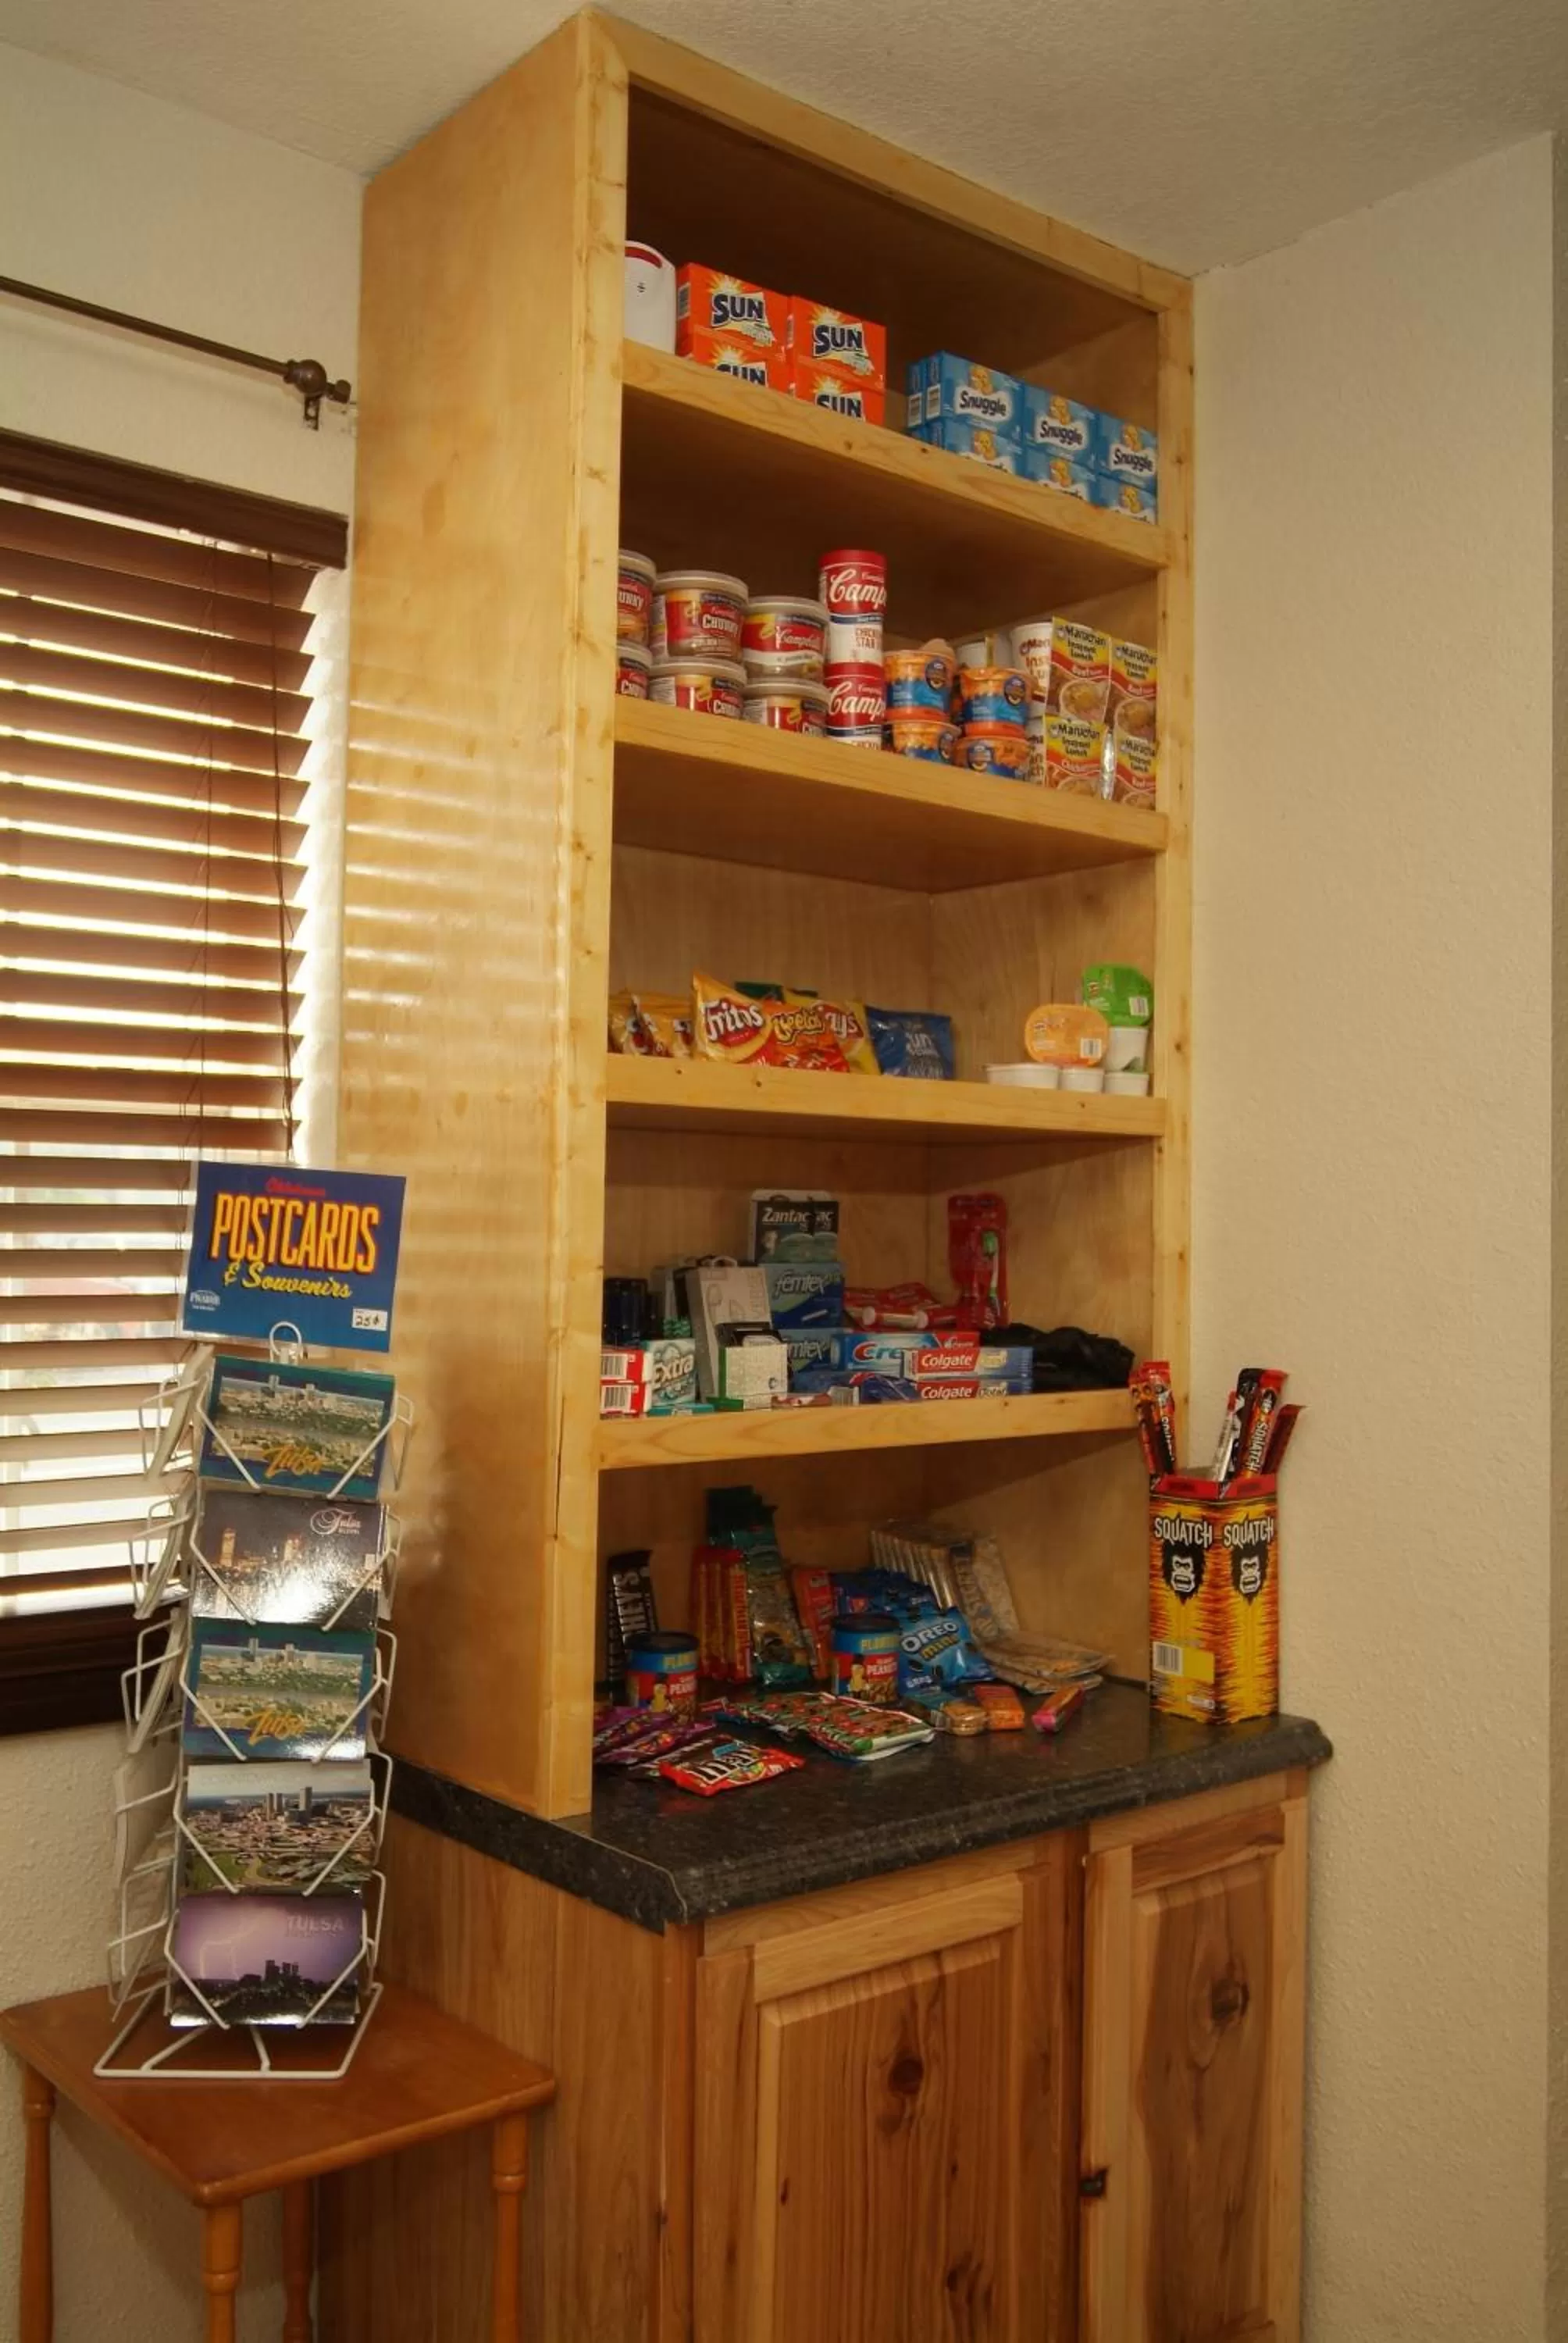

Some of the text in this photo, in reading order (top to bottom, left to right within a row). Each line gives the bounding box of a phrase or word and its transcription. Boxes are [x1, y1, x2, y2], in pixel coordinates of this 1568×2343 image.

[711, 292, 764, 326] SUN
[814, 323, 863, 355] SUN
[959, 390, 1007, 415] Snuggle
[1039, 420, 1083, 446] Snuggle
[1113, 448, 1153, 474] Snuggle
[618, 590, 644, 612] UNKY
[703, 613, 739, 637] CHUNKY
[1065, 625, 1107, 647] Maruchan
[704, 1000, 764, 1042] Fritos
[761, 1207, 811, 1223] Zantac
[208, 1192, 380, 1275] POSTCARDS
[223, 1259, 352, 1300] & Souvenirs
[651, 1353, 694, 1390] Extra
[921, 1353, 974, 1370] Colgate
[921, 1385, 973, 1400] Colgate
[1154, 1515, 1213, 1549] SQUATCH
[1224, 1513, 1274, 1551] SQUATCH
[901, 1621, 959, 1653] OREO
[287, 1915, 344, 1931] TULSA
